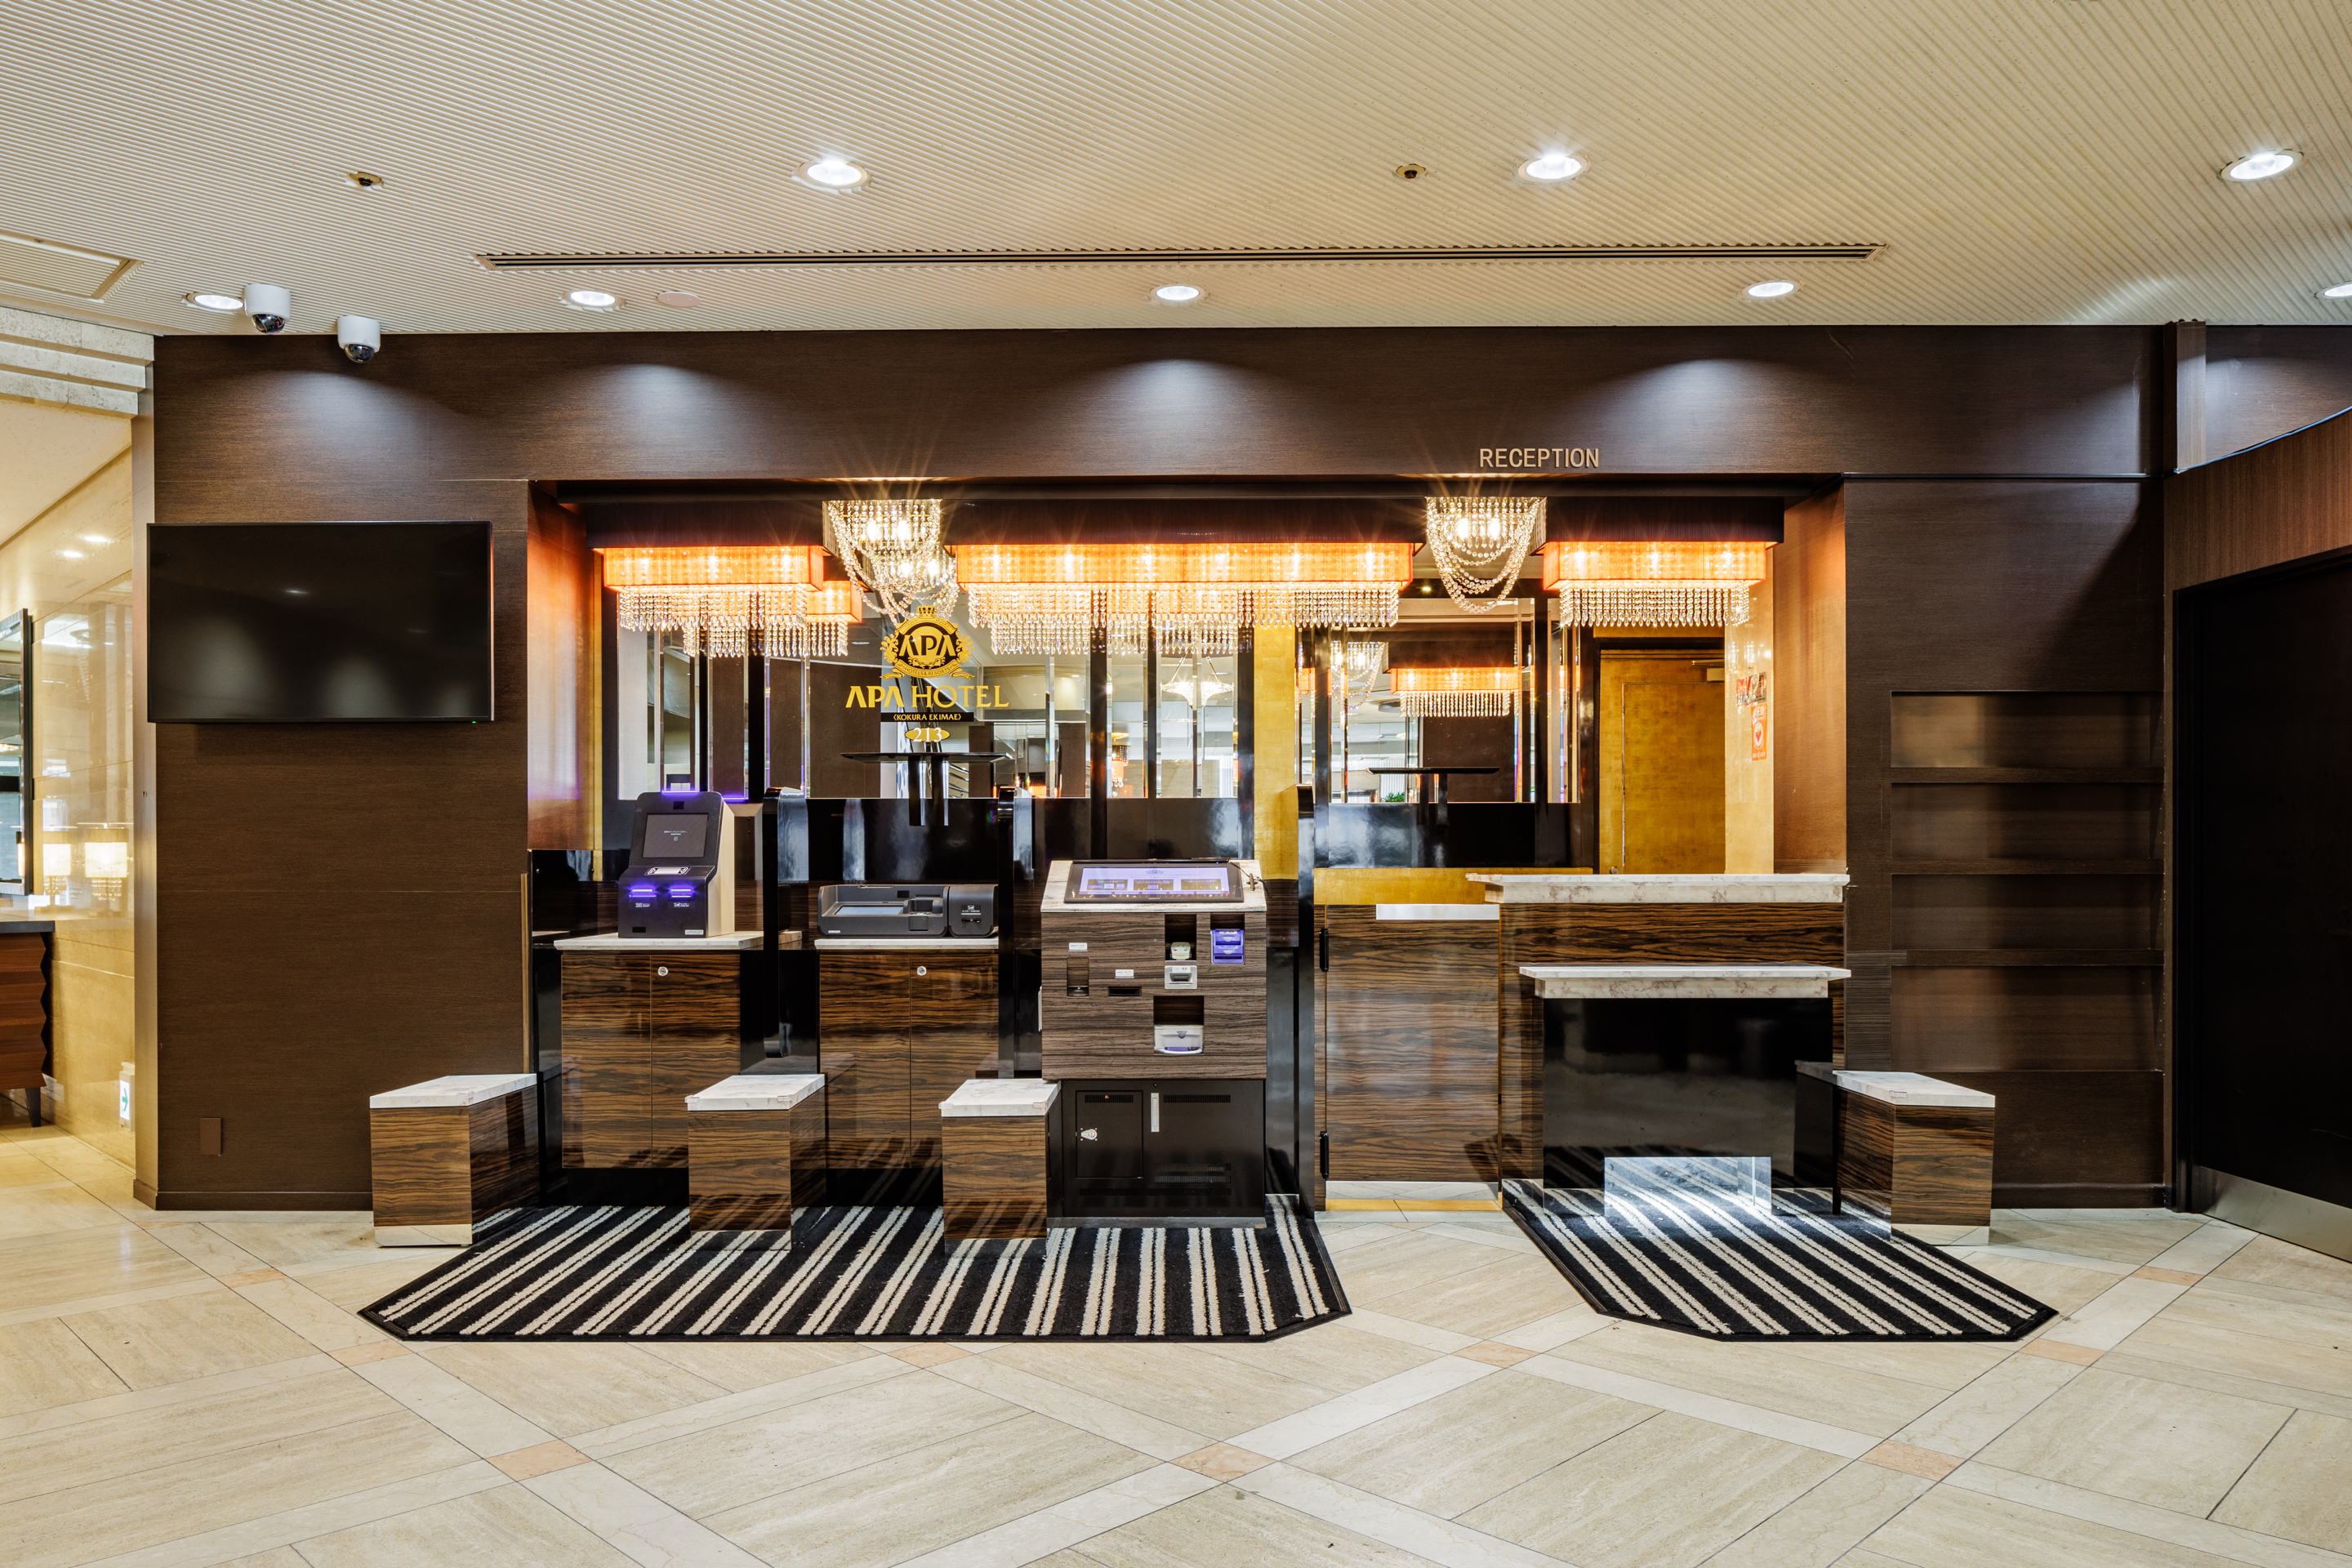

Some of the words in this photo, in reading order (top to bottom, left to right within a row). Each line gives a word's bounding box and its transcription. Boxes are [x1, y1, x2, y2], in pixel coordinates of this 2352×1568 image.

[1479, 448, 1599, 468] RECEPTION
[898, 635, 957, 657] APA
[845, 685, 904, 708] APA
[911, 685, 1009, 709] HOTEL
[912, 727, 942, 742] 213
